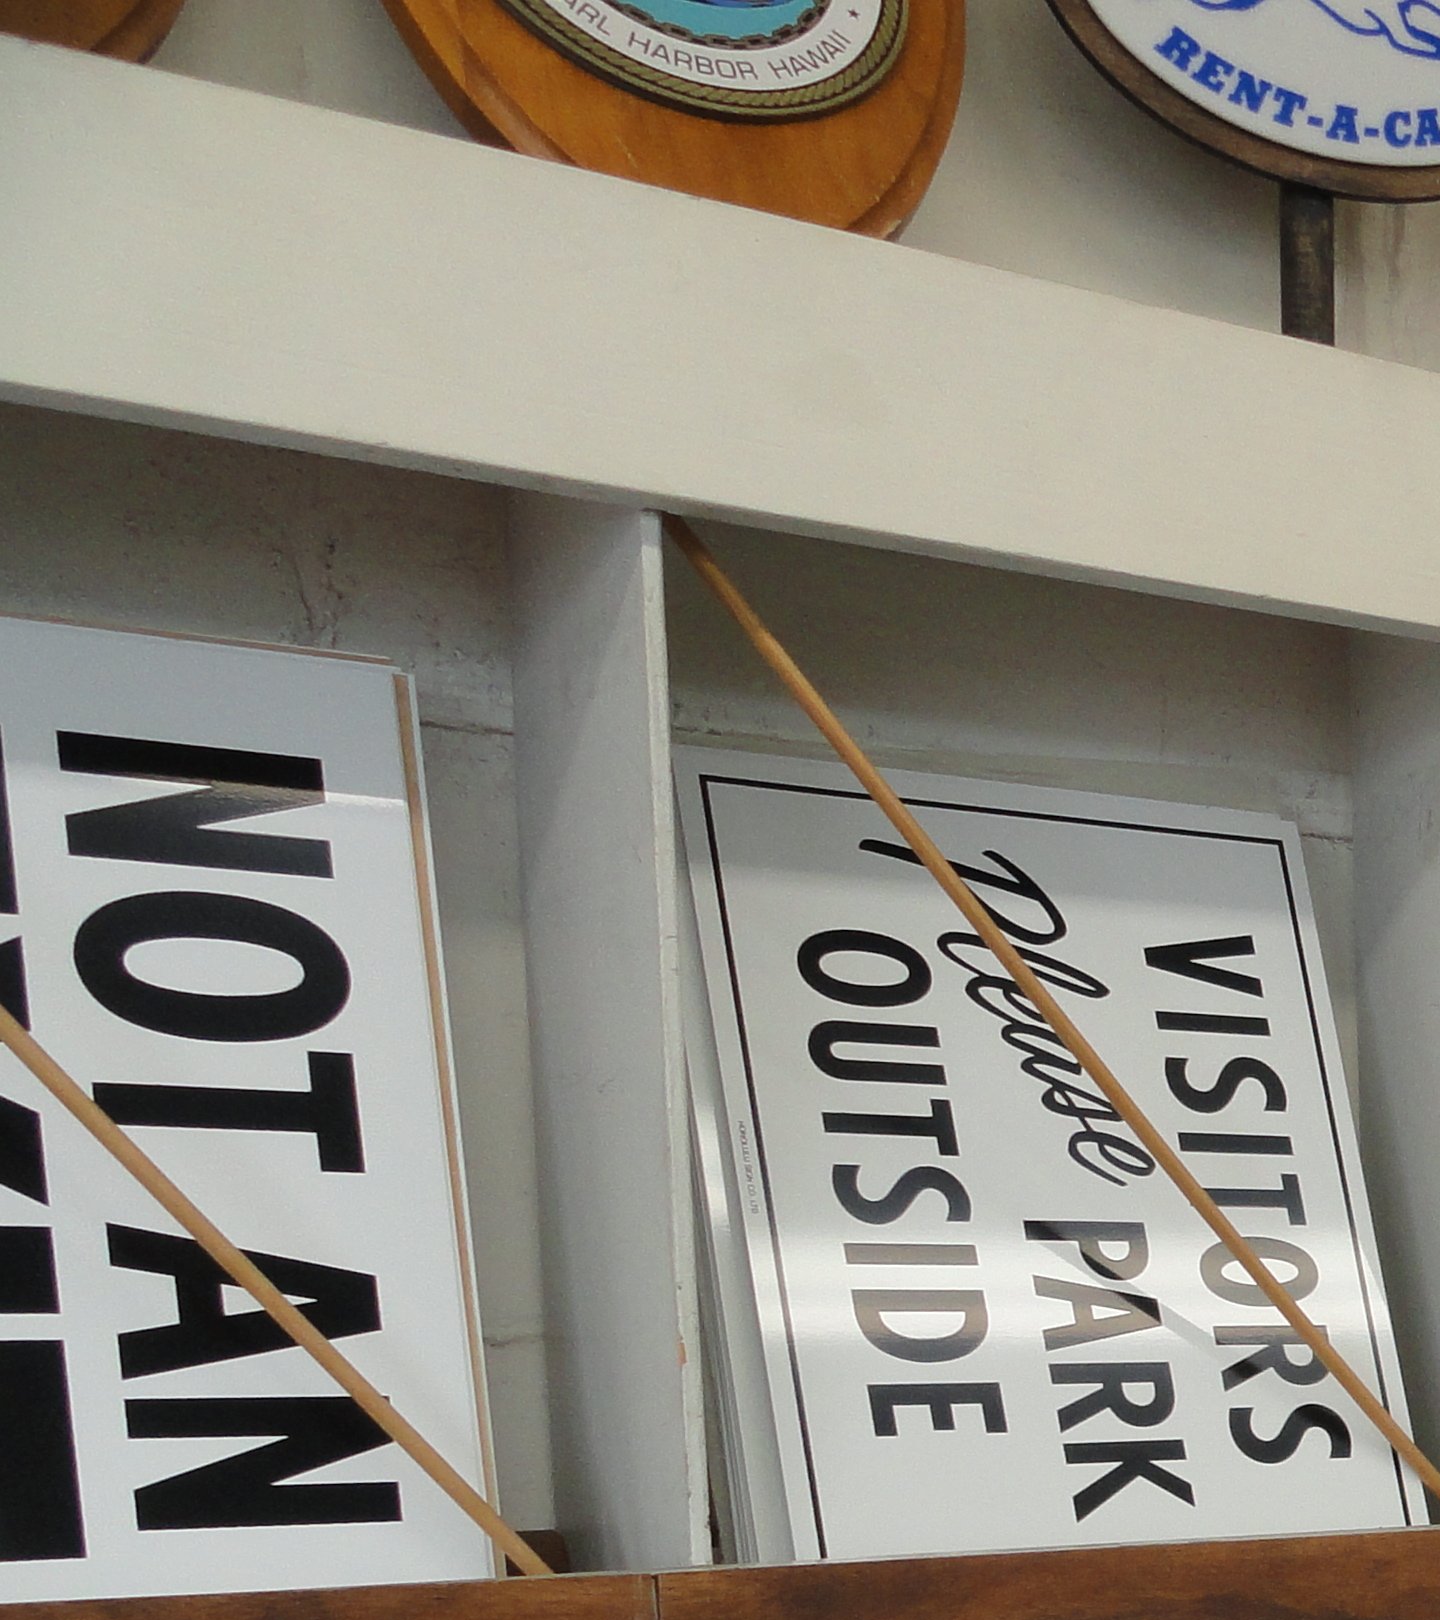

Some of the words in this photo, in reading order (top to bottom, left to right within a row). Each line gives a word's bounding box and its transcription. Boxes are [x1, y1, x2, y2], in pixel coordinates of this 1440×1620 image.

[629, 31, 757, 79] HARBOR
[768, 29, 851, 80] HAWAII
[57, 730, 366, 1173] NOT
[796, 929, 1008, 1437] OUTSIDE
[859, 838, 1157, 1188] Please
[1023, 1220, 1196, 1522] PARK
[106, 1223, 404, 1530] AN
[1144, 935, 1352, 1464] VISITORS
